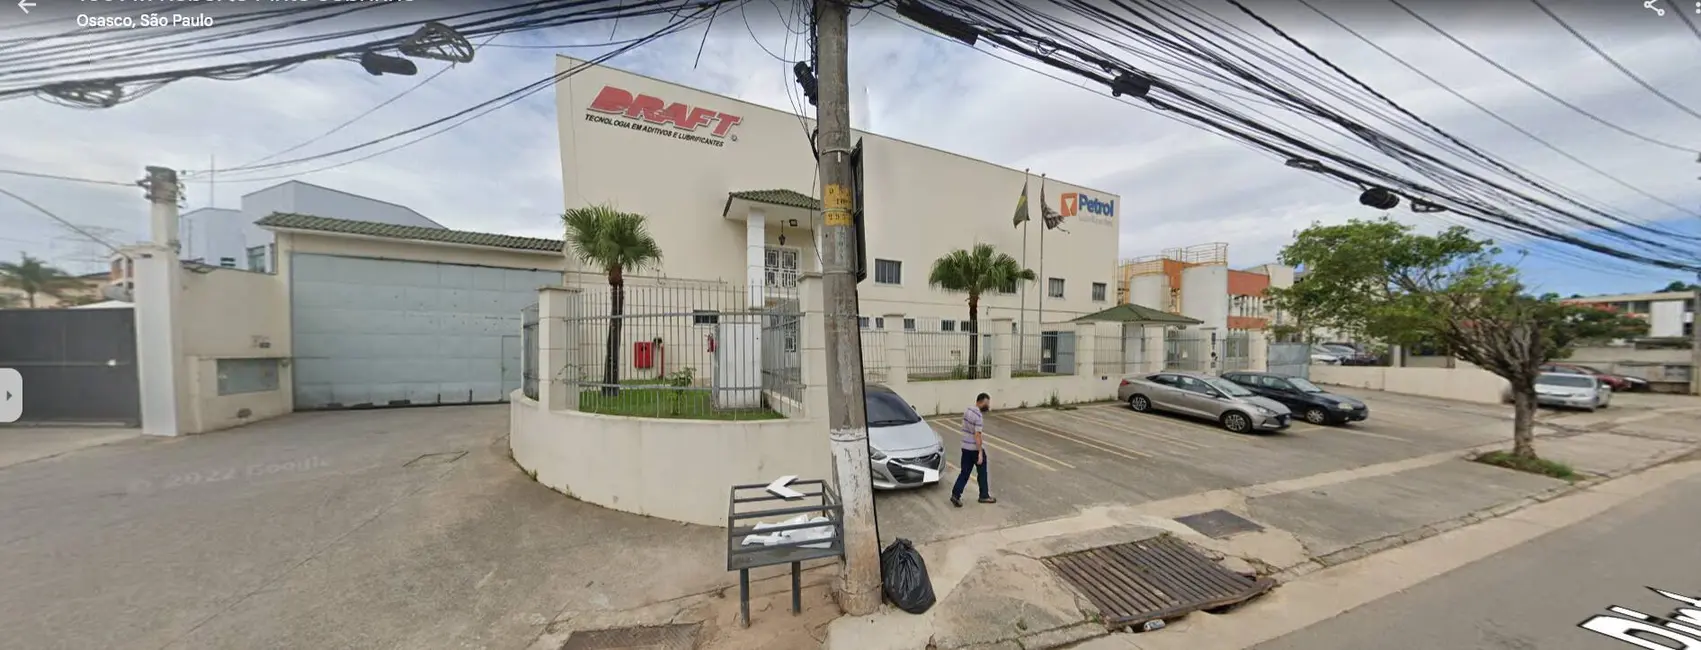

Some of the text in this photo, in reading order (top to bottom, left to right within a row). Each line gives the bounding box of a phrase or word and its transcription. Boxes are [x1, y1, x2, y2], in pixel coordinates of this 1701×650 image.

[587, 85, 743, 137] DRAFT
[585, 113, 631, 129] TECNOLOGIA
[631, 123, 643, 131] EM
[642, 125, 673, 137] ADITIVOS
[679, 133, 724, 147] LUBRIFICANTES
[1079, 193, 1114, 217] Petrol
